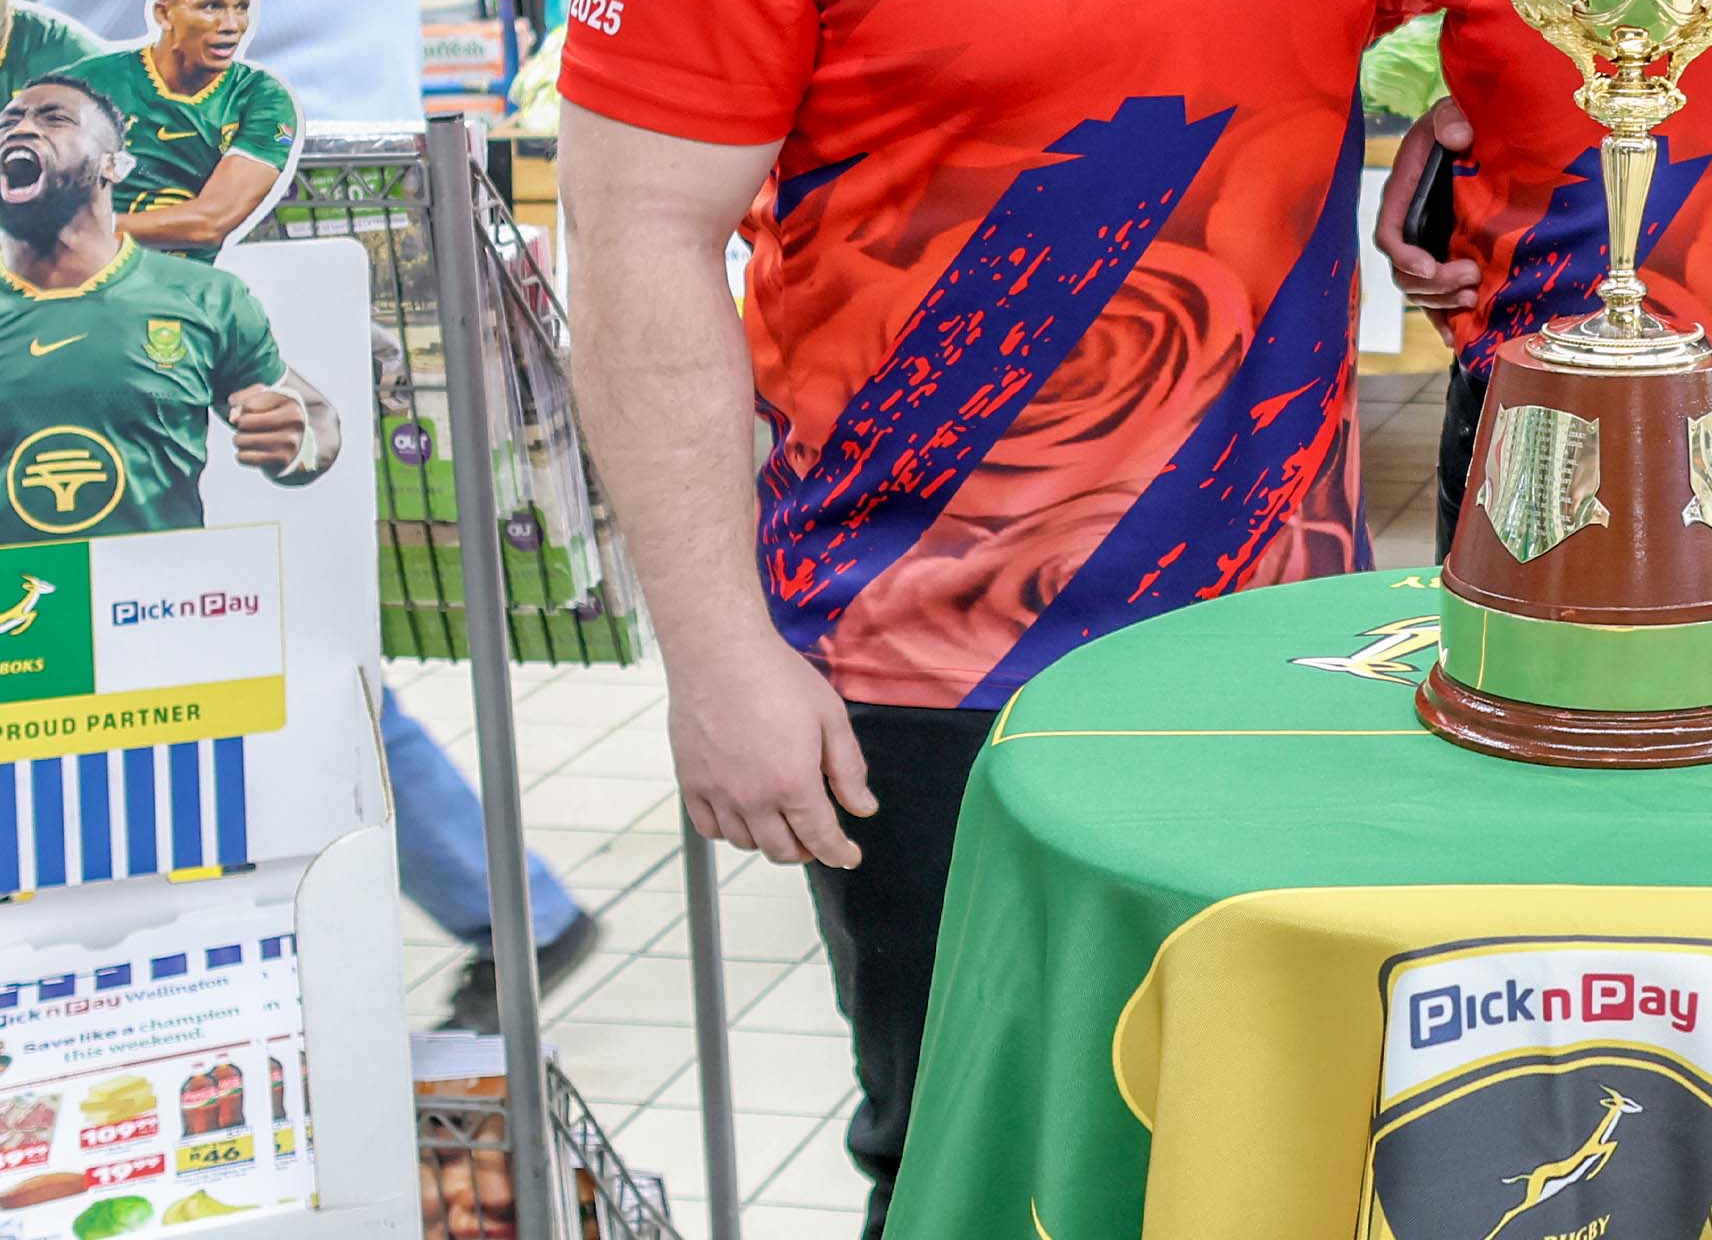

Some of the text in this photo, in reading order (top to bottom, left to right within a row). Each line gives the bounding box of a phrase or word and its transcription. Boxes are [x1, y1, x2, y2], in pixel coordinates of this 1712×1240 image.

[112, 592, 259, 627] Pick n Pay
[0, 704, 202, 745] ROUD PARTNER
[0, 1009, 41, 1029] ick
[124, 975, 231, 1004] Wellington
[1409, 973, 1700, 1050] Pick n Pay
[23, 1035, 76, 1055] Save
[79, 1026, 117, 1043] like
[138, 1006, 241, 1034] champion
